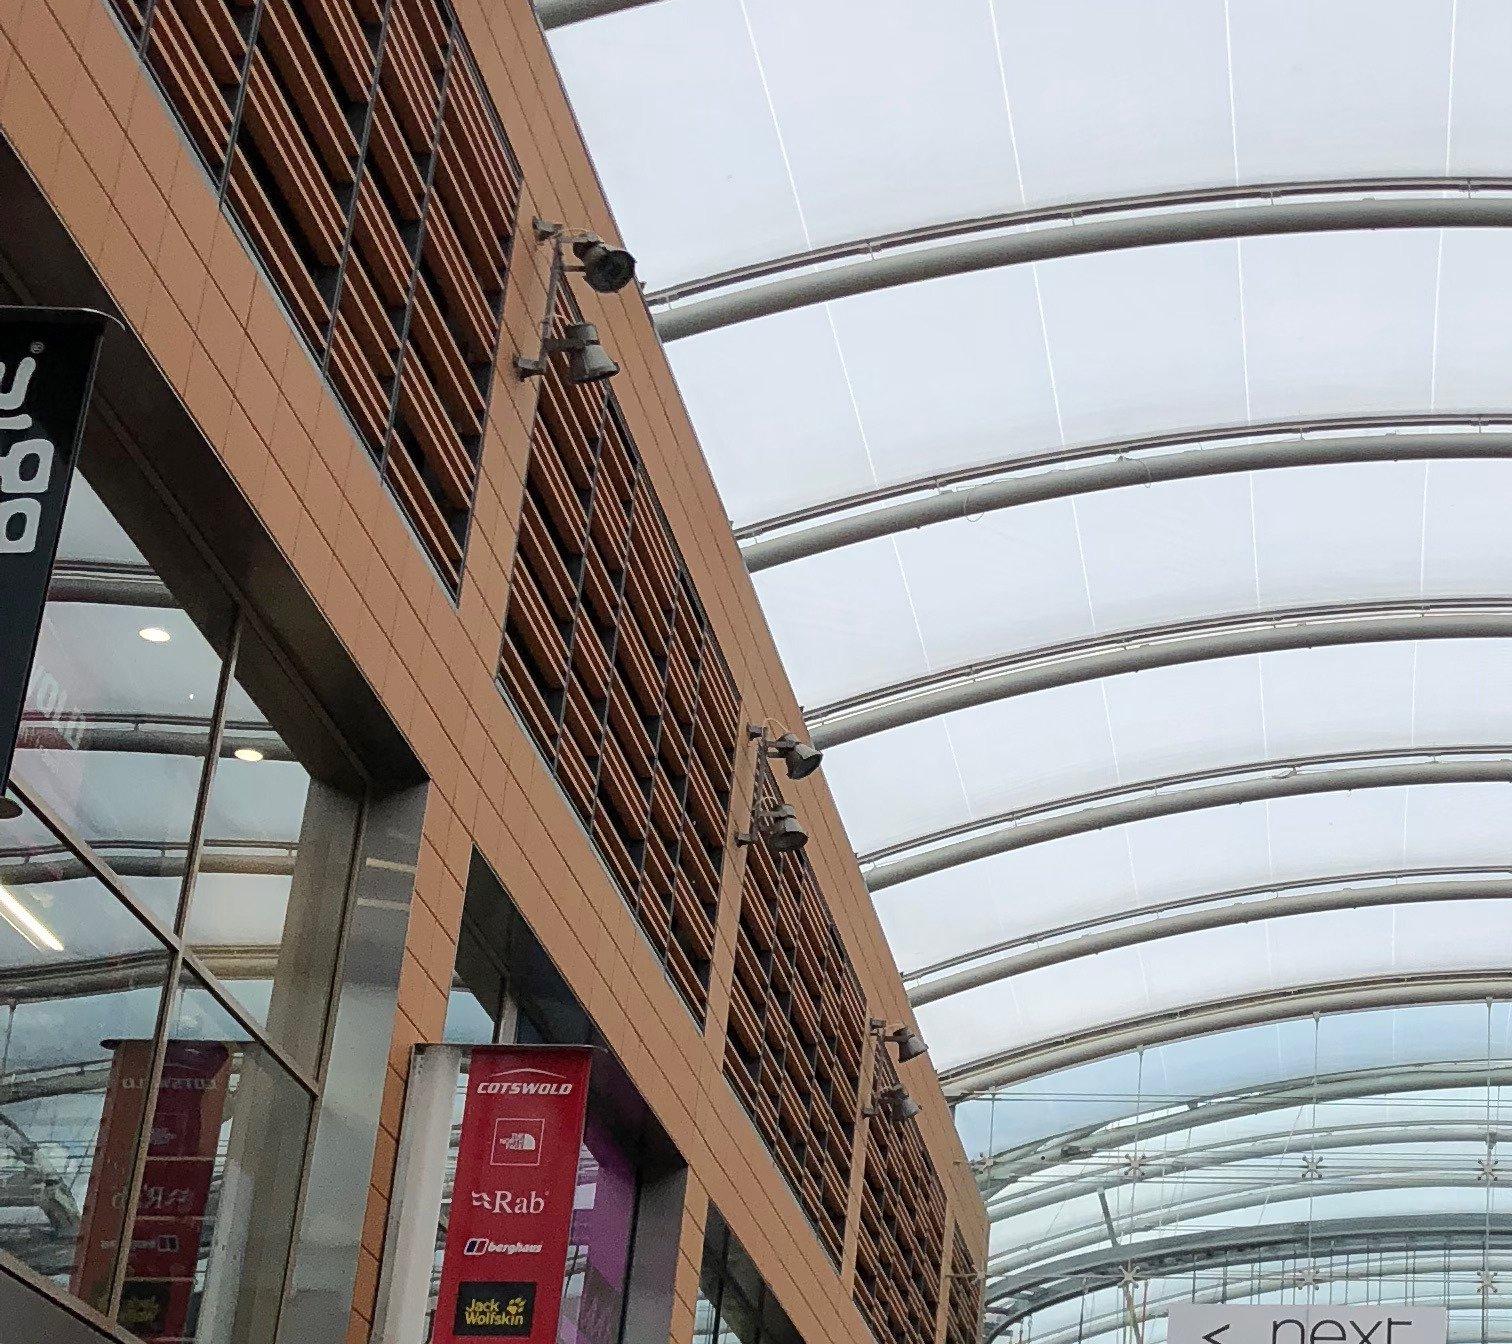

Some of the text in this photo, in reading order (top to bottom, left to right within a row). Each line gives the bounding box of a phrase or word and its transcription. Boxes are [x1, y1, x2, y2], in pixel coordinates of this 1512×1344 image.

[477, 1082, 573, 1095] COTSWOLD
[493, 1190, 545, 1214] Rab
[466, 1298, 499, 1313] Jack
[465, 1310, 524, 1326] Wolfskin
